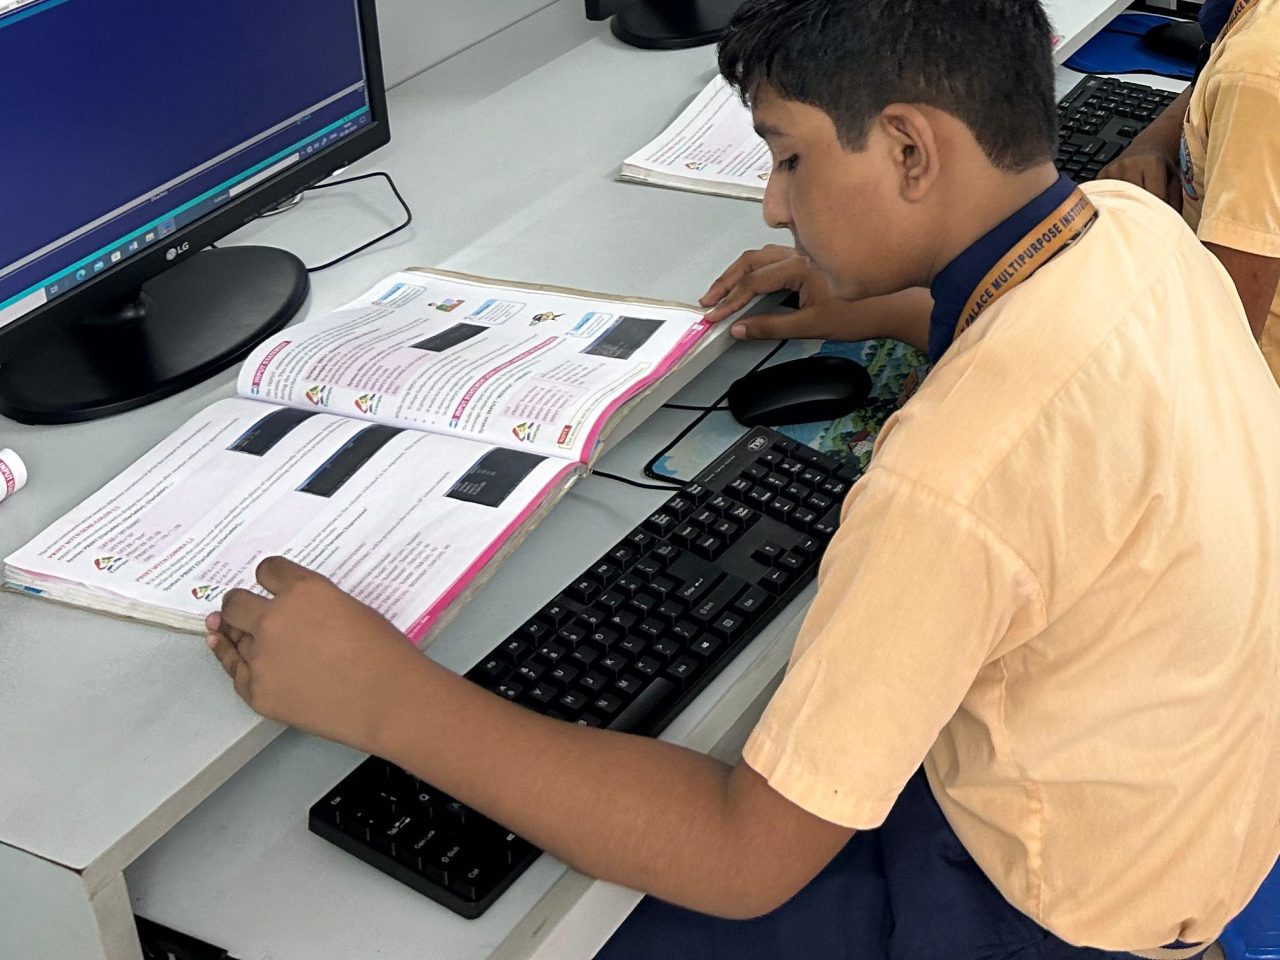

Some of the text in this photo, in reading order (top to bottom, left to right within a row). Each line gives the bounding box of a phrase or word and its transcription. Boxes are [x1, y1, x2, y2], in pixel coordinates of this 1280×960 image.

[176, 242, 189, 254] LG
[965, 288, 994, 328] PALACE
[991, 223, 1063, 291] MULTIPURPOSE
[254, 365, 265, 384] INPUT
[456, 399, 467, 416] INPUT
[559, 427, 569, 442] NOTE
[45, 544, 68, 558] PRINT
[63, 532, 83, 545] WITH
[133, 569, 154, 582] PRINT
